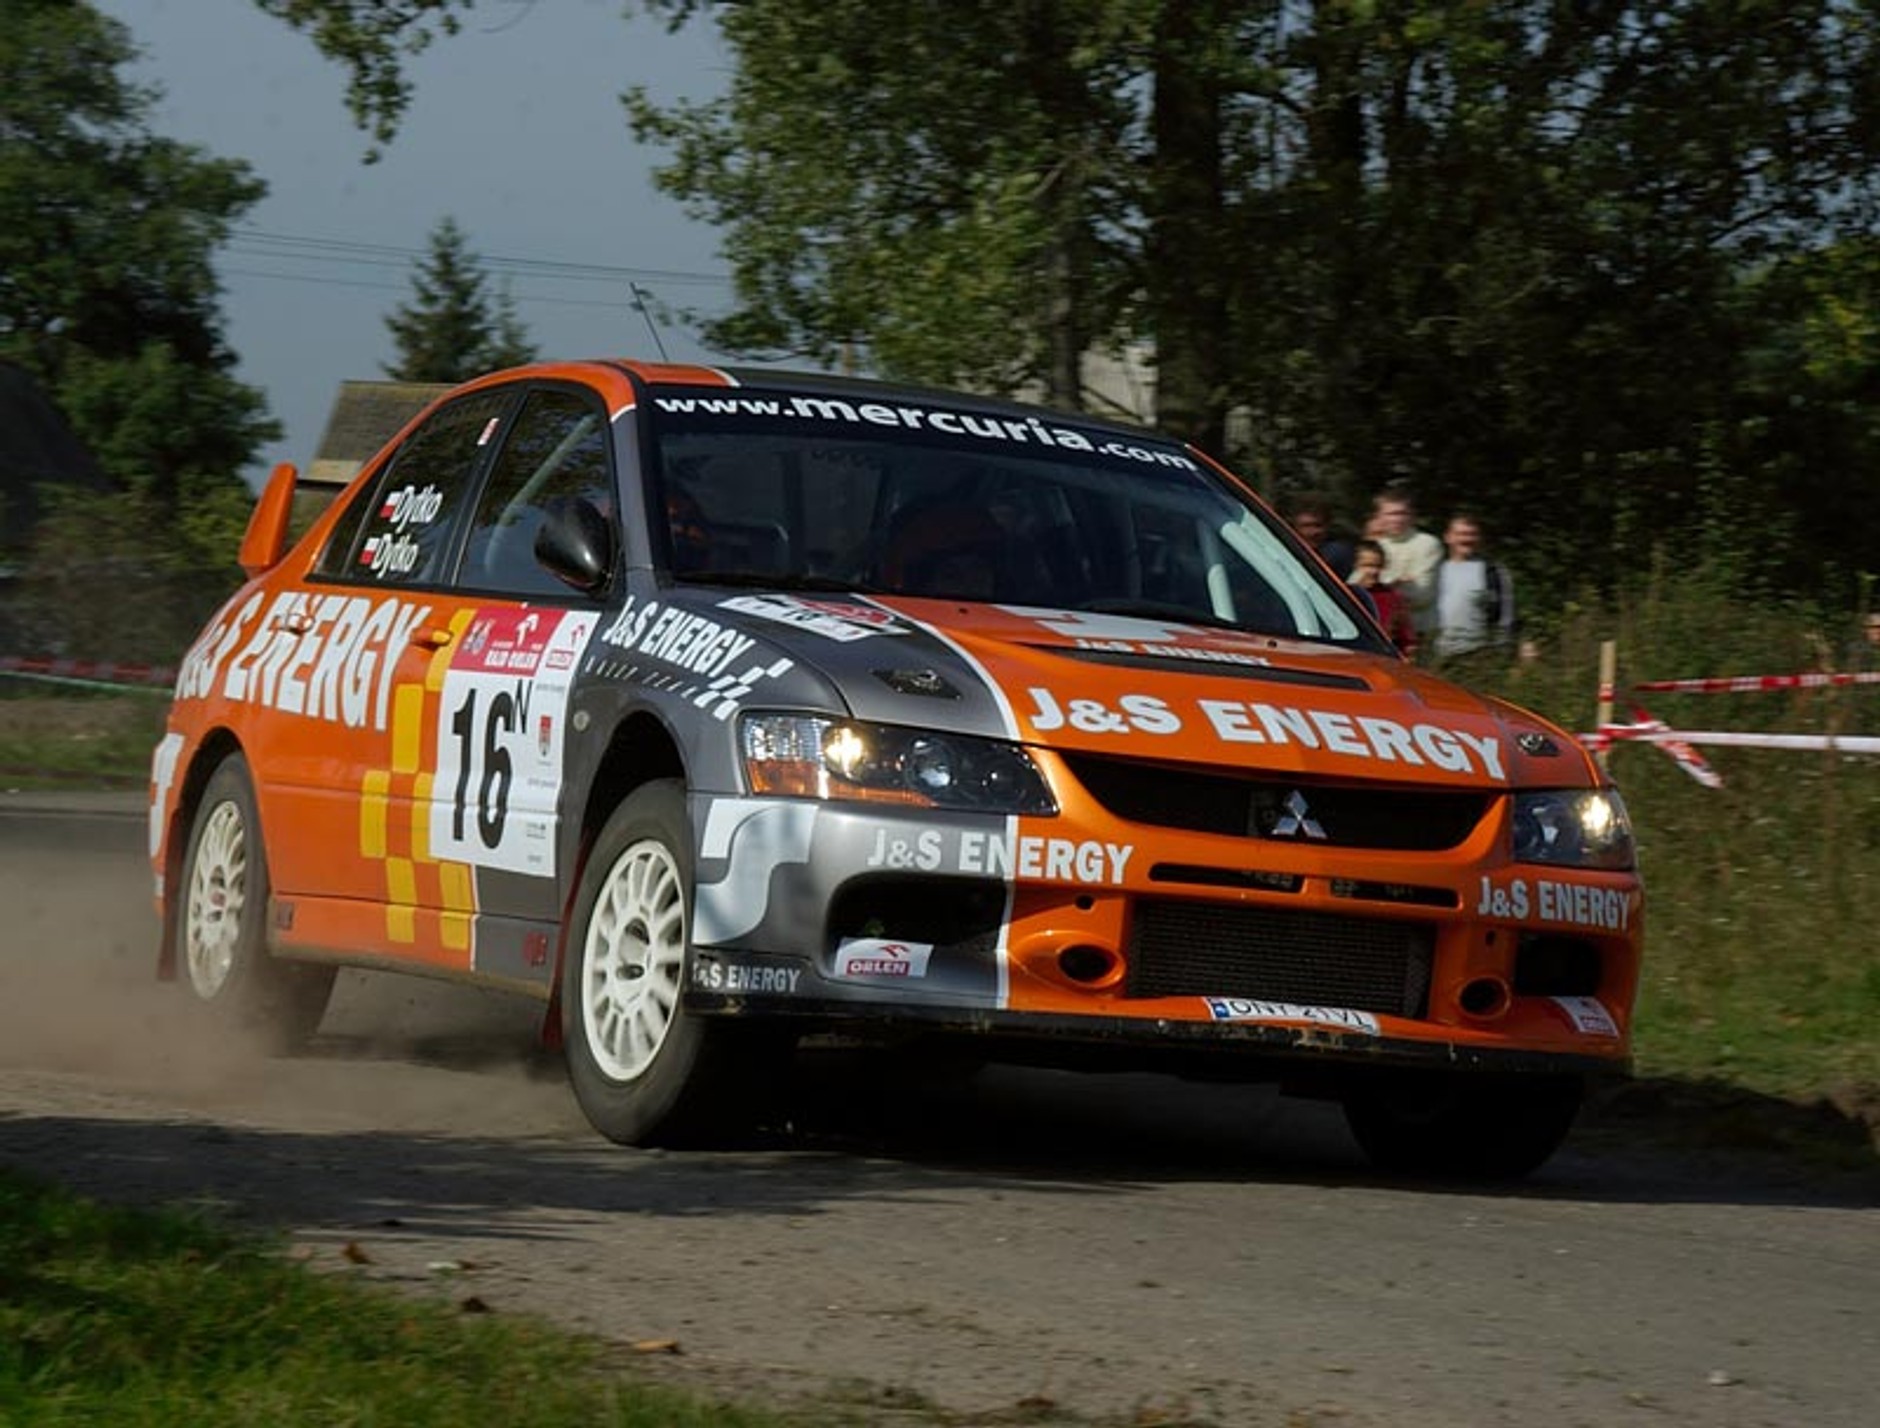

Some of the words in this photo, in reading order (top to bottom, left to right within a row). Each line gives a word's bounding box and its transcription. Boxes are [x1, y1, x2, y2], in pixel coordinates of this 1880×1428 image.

[655, 397, 1198, 472] www.mercuria.com
[389, 484, 444, 533] Dytko
[369, 533, 418, 579] Dytko
[223, 591, 432, 732] ENERGY
[601, 595, 659, 649] J&S
[638, 607, 756, 678] ENERGY
[1027, 687, 1181, 735] J&S
[1197, 699, 1506, 781] ENERGY
[452, 688, 512, 850] 16
[867, 829, 942, 871] J&S
[958, 831, 1134, 885] ENERGY
[1478, 876, 1530, 920] J&S
[1538, 880, 1631, 931] ENERGY
[726, 964, 801, 993] ENERGY
[850, 960, 908, 976] ORLEN
